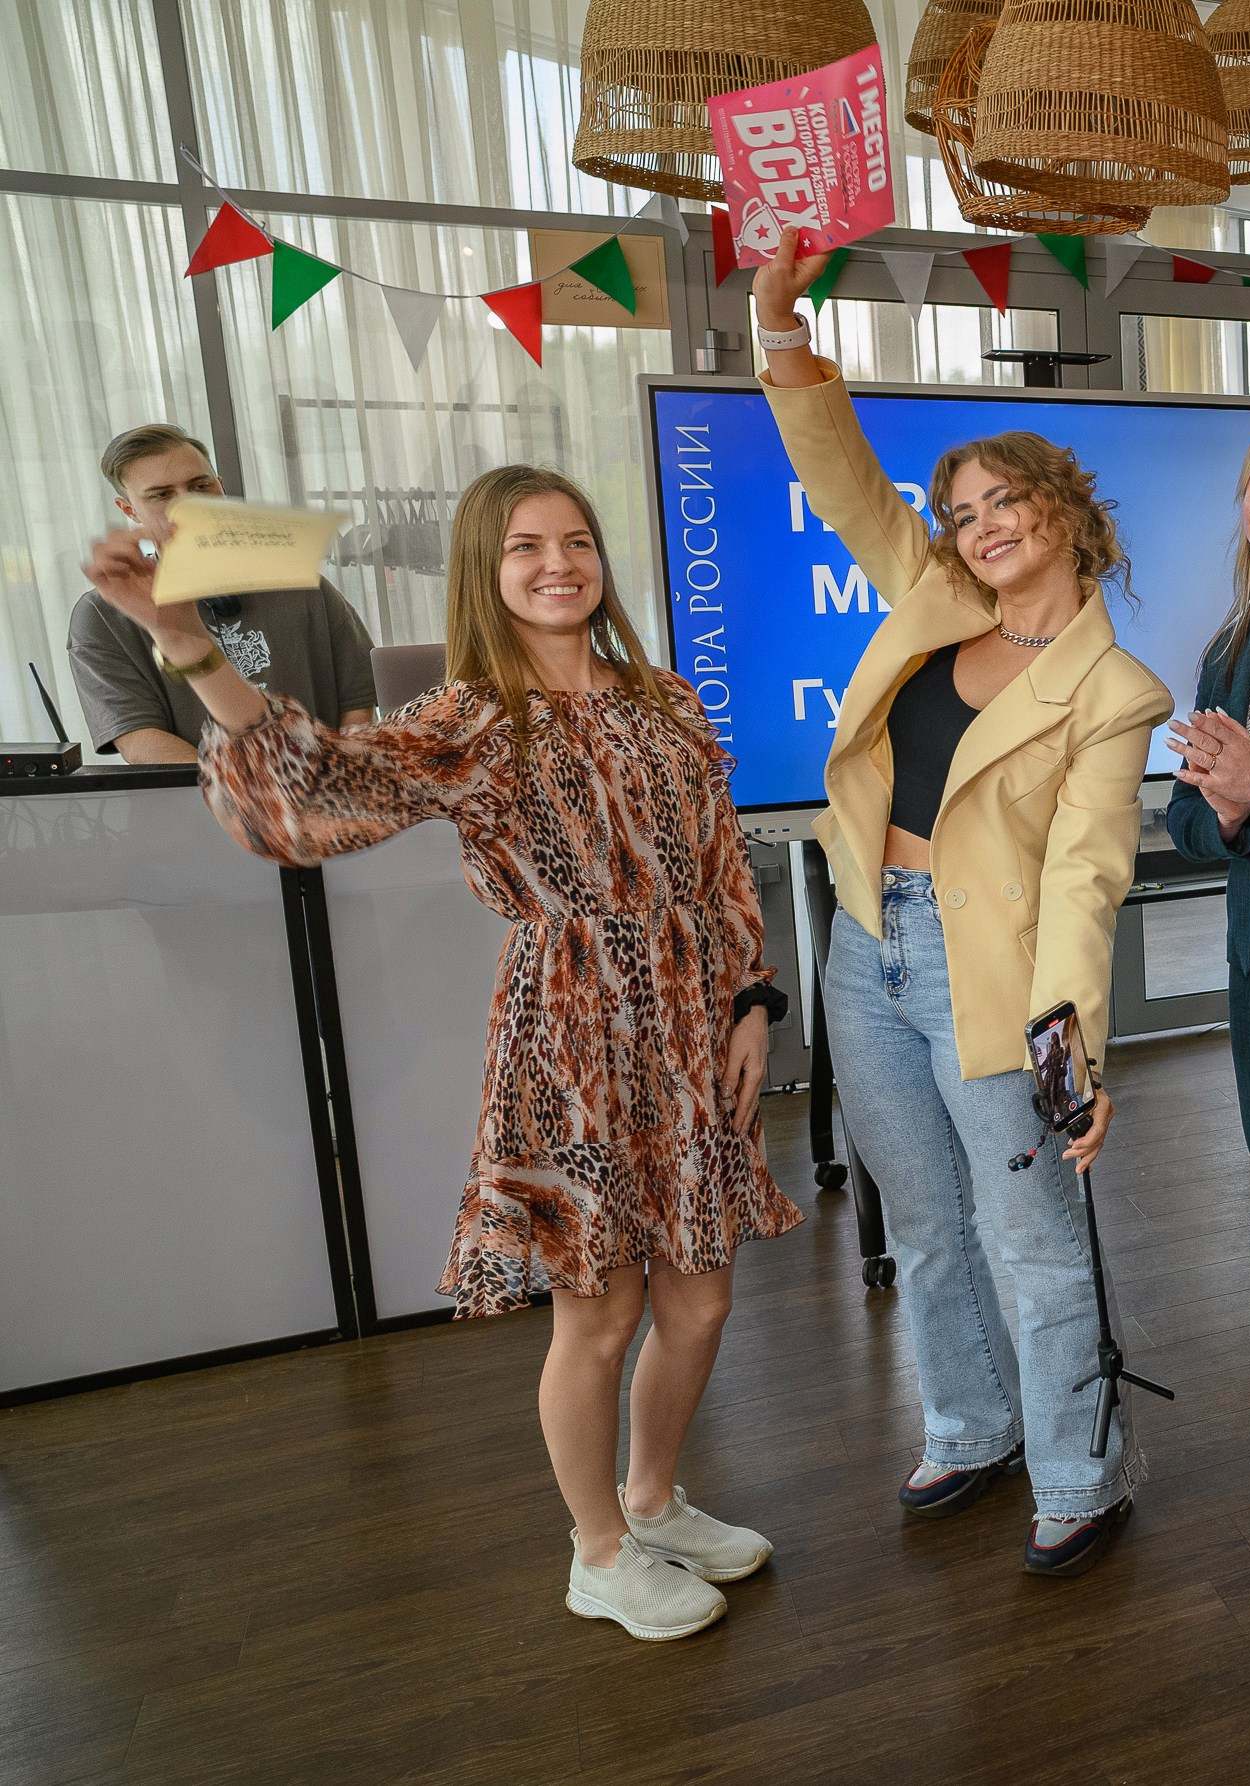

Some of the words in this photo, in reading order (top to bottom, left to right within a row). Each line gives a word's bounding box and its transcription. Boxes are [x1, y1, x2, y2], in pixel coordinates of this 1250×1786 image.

[856, 64, 878, 85] 1
[730, 109, 822, 231] ВСЕХ
[792, 106, 818, 164] КОТОРАЯ
[809, 166, 831, 226] РАЗНЕСЛА
[807, 102, 838, 192] КОМАНДЕ,
[858, 86, 887, 193] МЕСТО
[675, 423, 724, 616] РОССИИ
